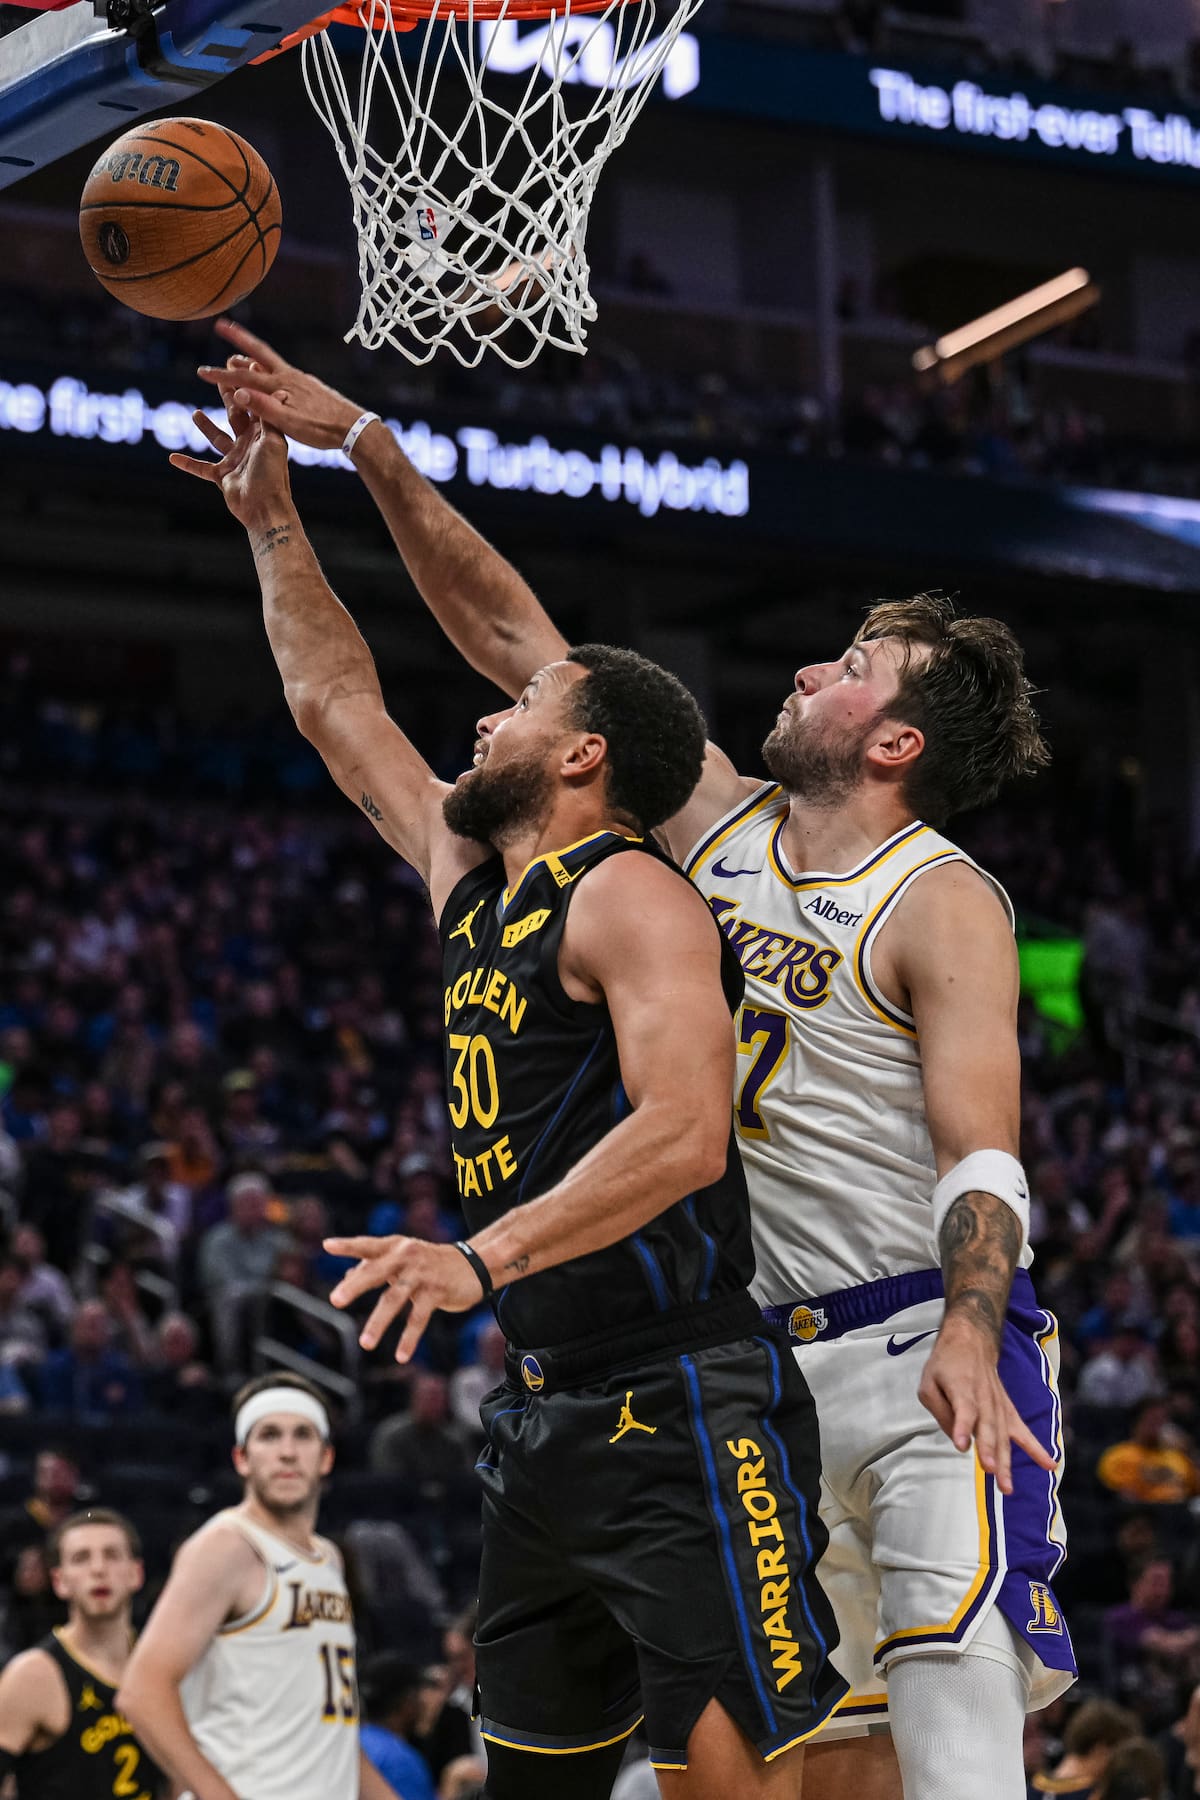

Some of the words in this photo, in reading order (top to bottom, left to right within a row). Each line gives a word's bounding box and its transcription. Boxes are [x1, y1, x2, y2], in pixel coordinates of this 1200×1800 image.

[869, 67, 949, 129] The
[952, 80, 1124, 155] first-ever
[91, 152, 181, 192] Wilso
[457, 427, 748, 517] Turbo-Hybrid
[707, 894, 844, 1010] KERS
[804, 895, 863, 927] Albert
[444, 967, 528, 1035] GOLEN
[449, 1033, 500, 1130] 30
[733, 1006, 792, 1141] 7
[452, 1134, 518, 1198] TATE
[726, 1437, 802, 1692] WARRIORS
[319, 1641, 358, 1725] 15
[113, 1743, 140, 1797] 2
